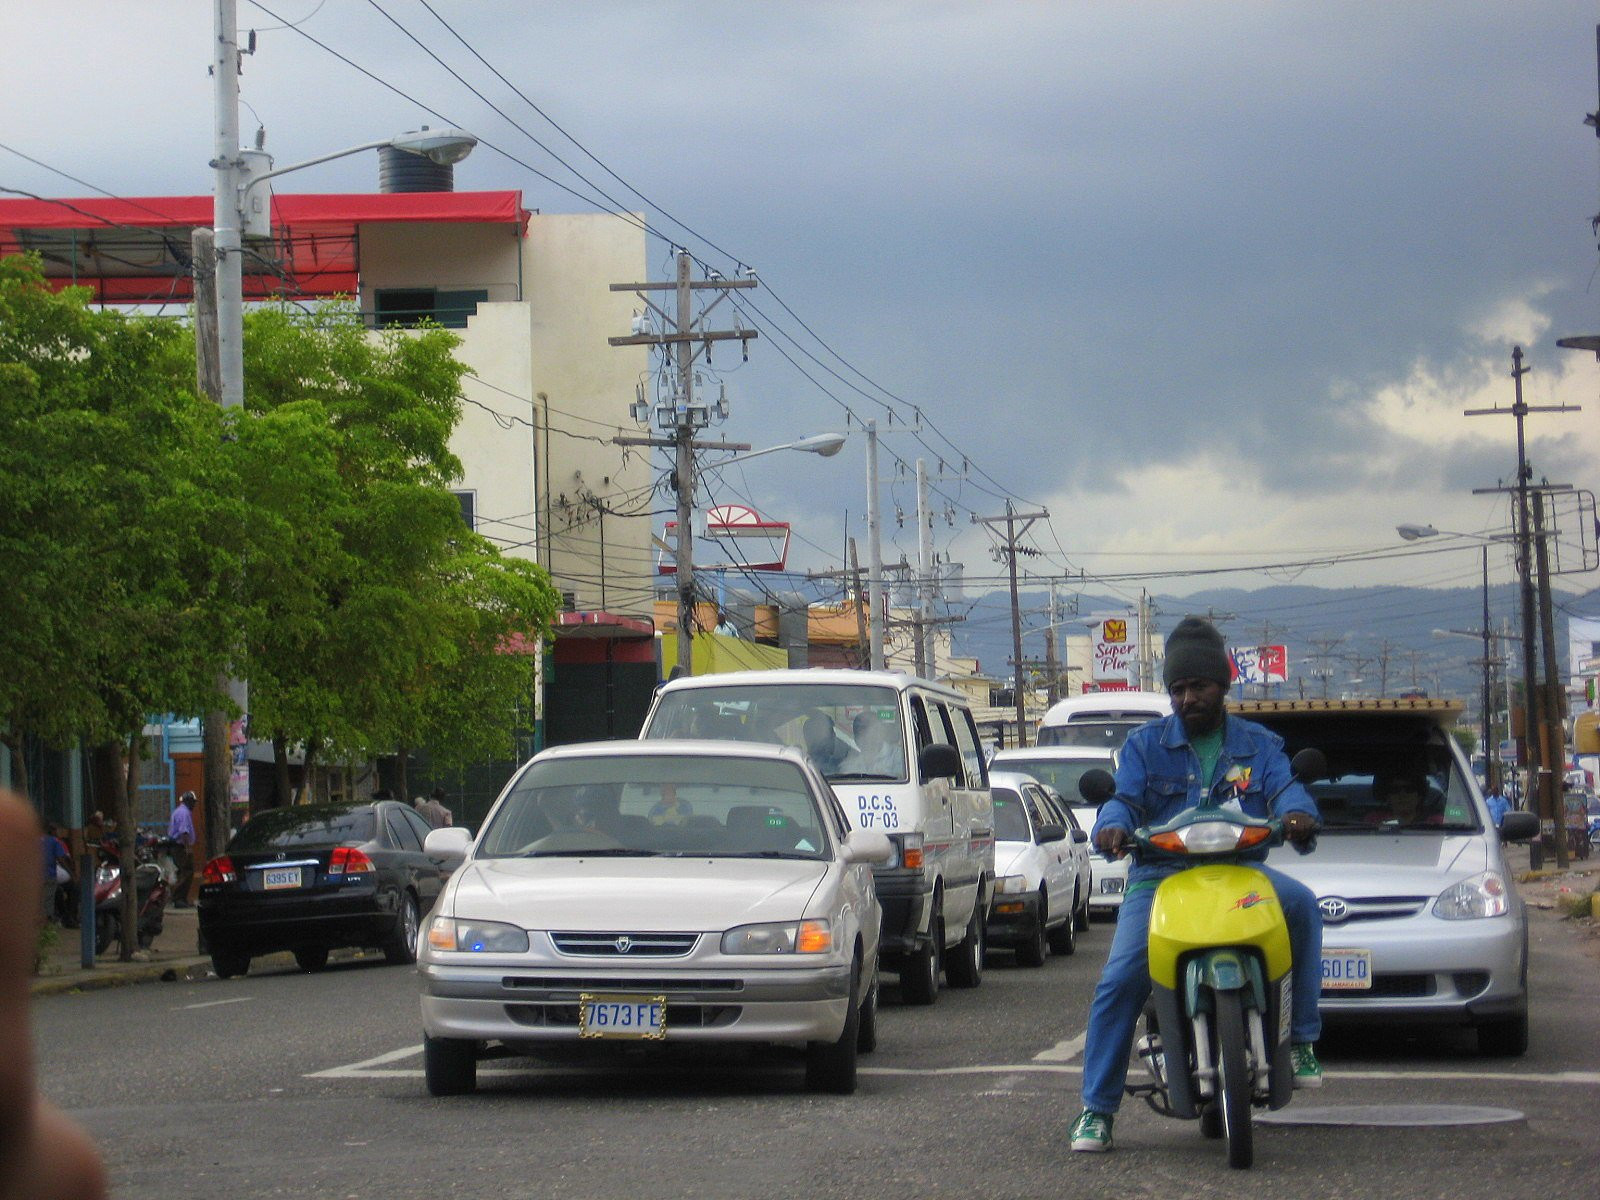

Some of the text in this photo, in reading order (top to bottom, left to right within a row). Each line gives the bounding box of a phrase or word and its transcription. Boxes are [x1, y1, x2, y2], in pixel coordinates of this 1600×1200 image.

[1095, 643, 1135, 658] Super
[858, 795, 897, 810] D.C.S.
[860, 812, 898, 828] 07-03
[586, 1004, 661, 1026] 7673 FE
